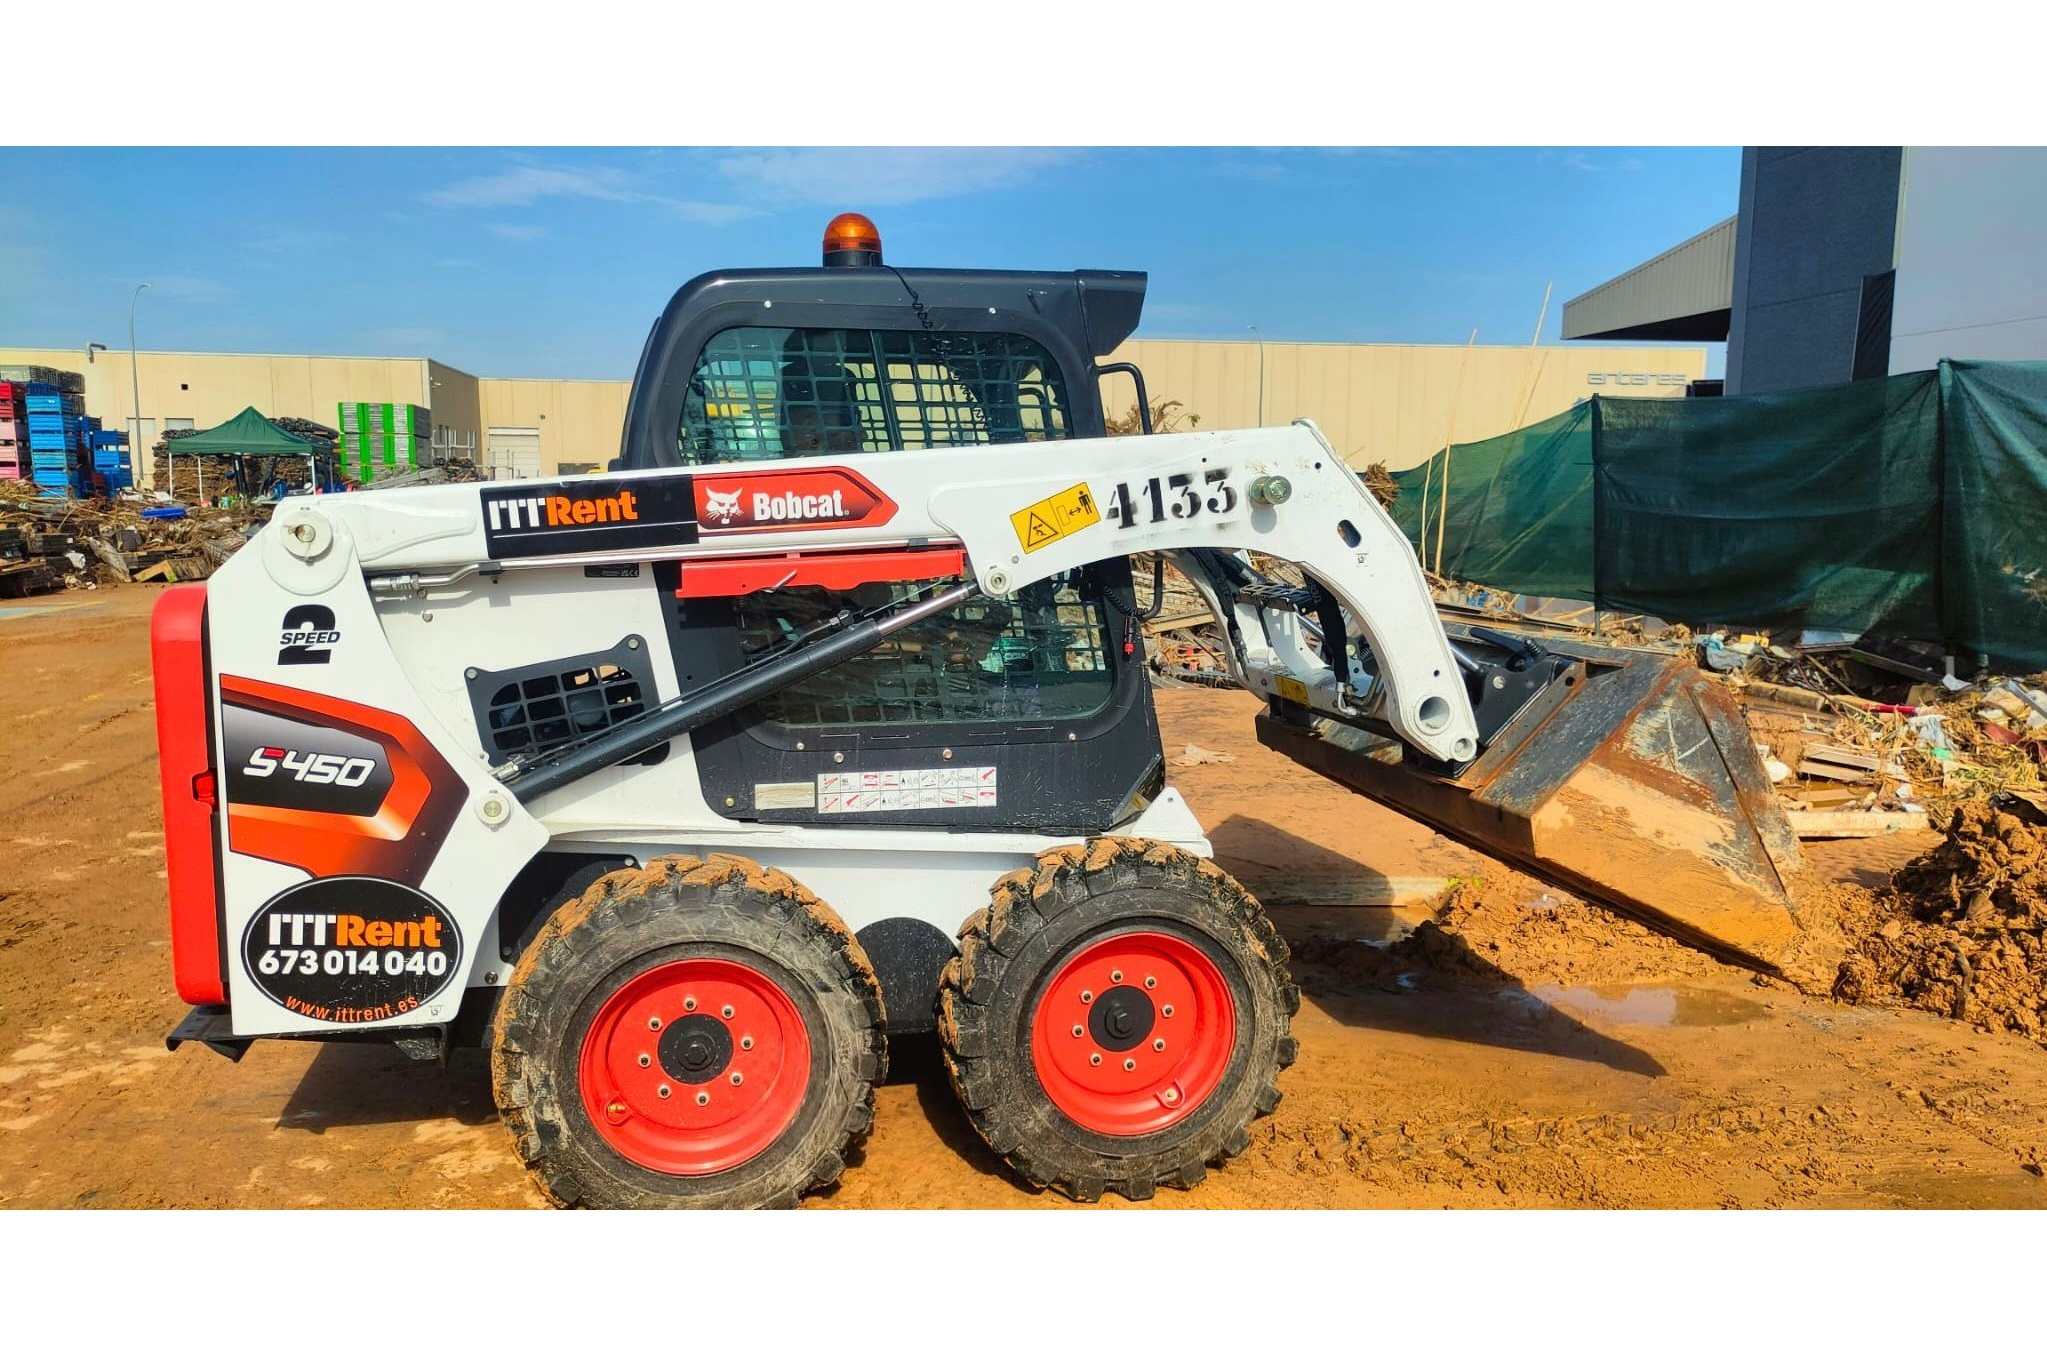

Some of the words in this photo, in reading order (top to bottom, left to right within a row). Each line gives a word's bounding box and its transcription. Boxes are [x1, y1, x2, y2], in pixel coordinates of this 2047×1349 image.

[1586, 373, 1687, 386] antares
[1105, 466, 1238, 530] 4133
[277, 604, 336, 665] 2
[280, 631, 341, 645] SPEED
[243, 747, 377, 788] S450
[258, 950, 318, 975] 673
[323, 951, 379, 976] 014
[384, 951, 447, 976] 040
[286, 996, 419, 1023] www.ittrent.es
